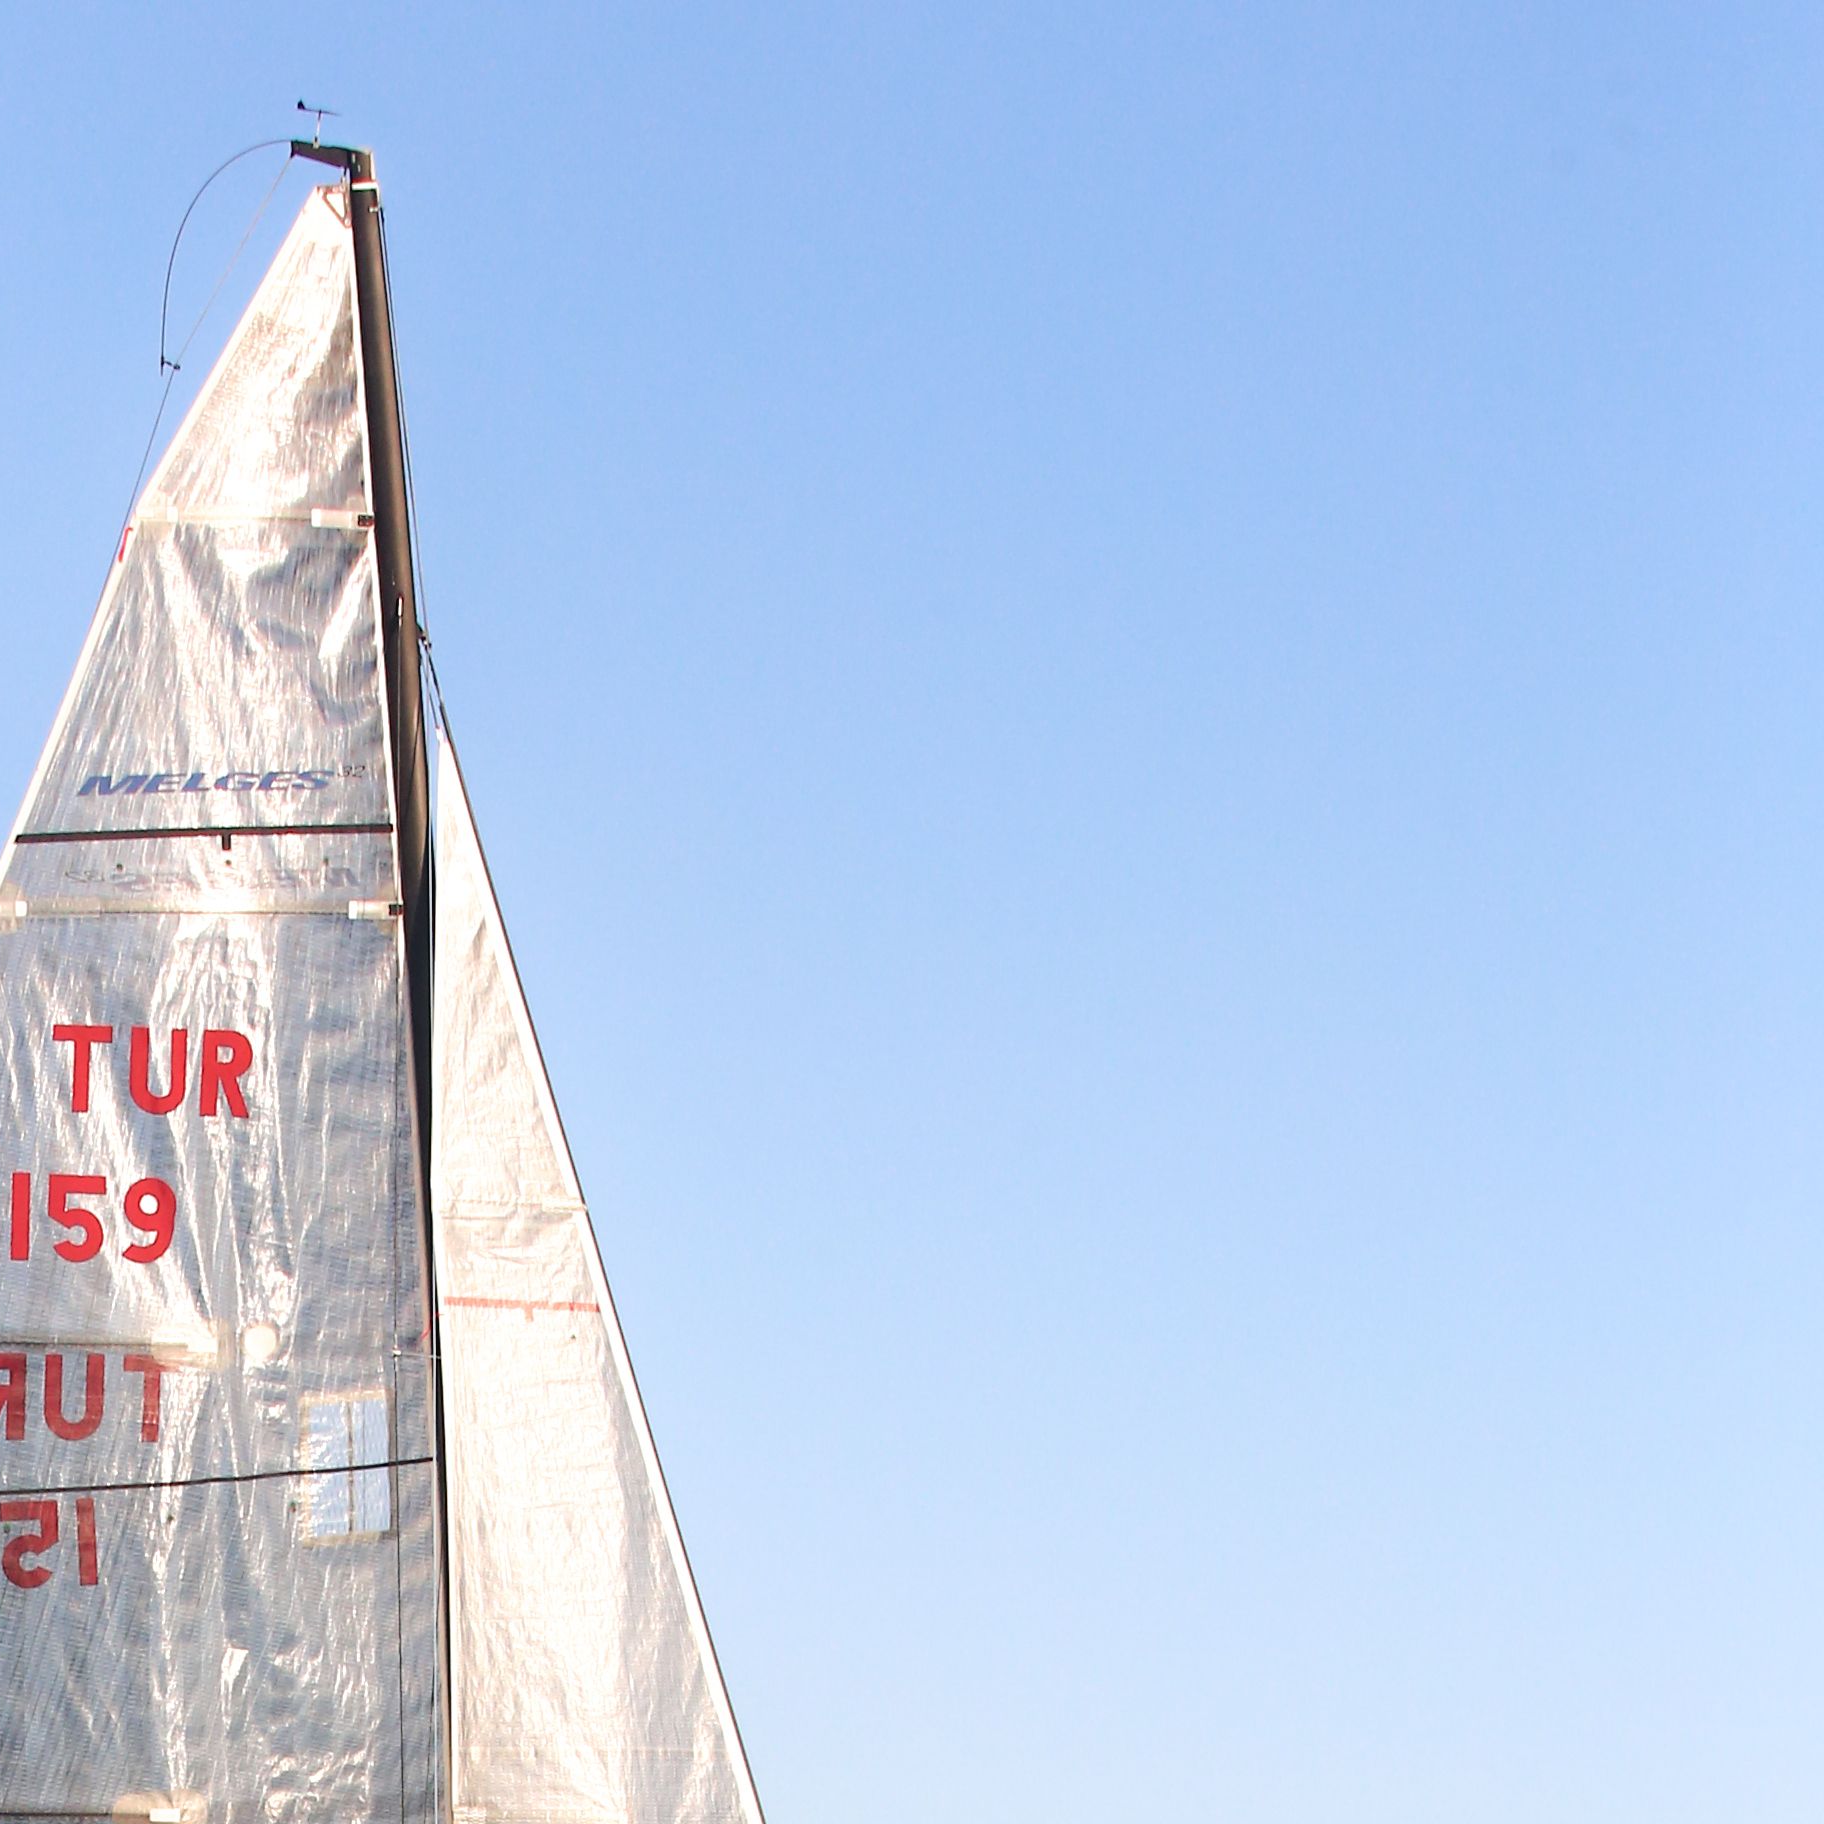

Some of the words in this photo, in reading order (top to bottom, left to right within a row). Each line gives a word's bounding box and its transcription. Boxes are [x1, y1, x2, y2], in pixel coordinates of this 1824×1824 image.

[77, 771, 334, 796] MELGES
[53, 1024, 253, 1118] TUR
[10, 1172, 176, 1264] 159
